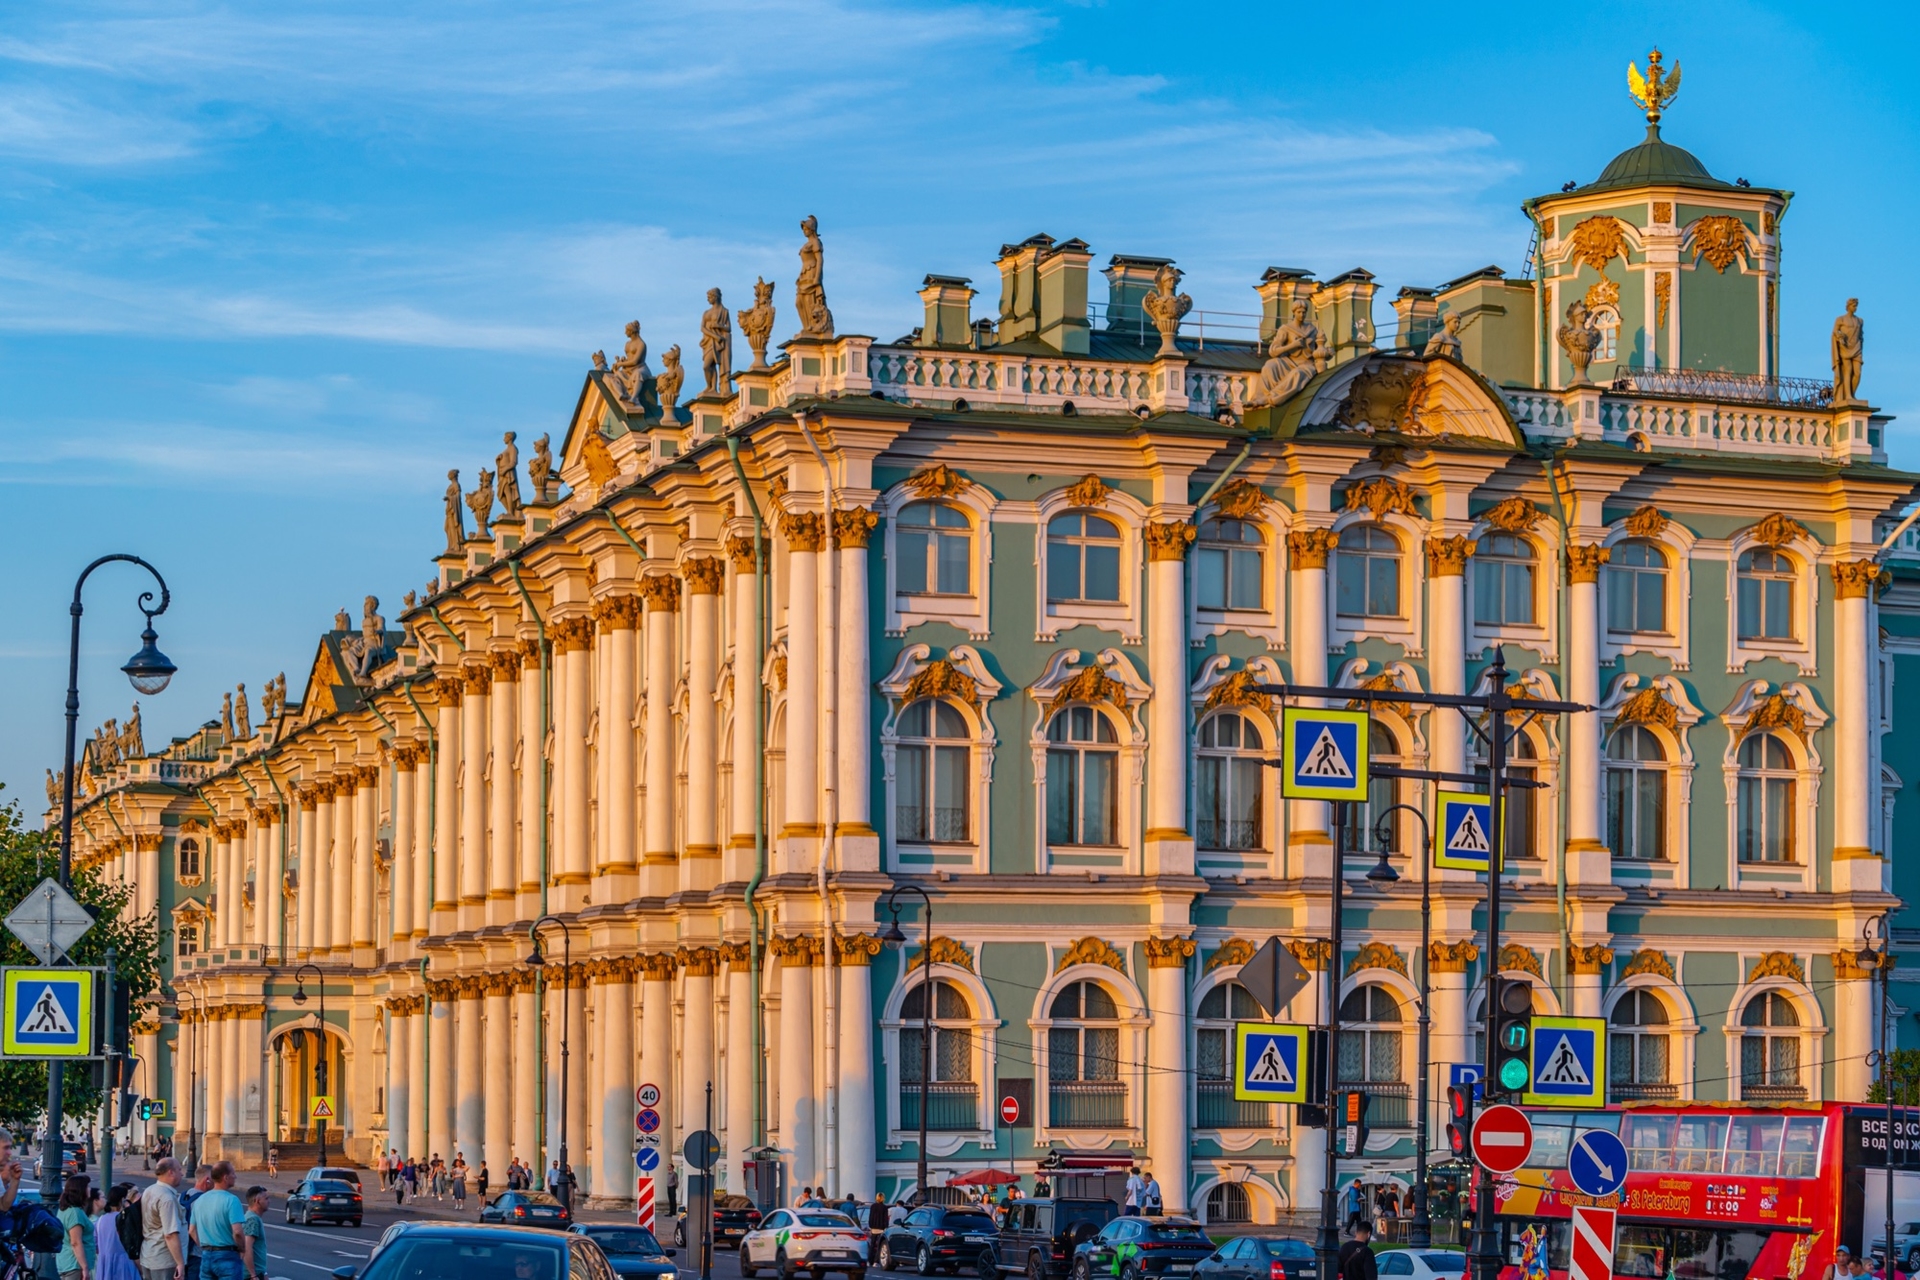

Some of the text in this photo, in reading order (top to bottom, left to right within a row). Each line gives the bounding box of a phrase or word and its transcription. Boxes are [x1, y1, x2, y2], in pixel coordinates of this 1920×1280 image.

[1510, 1026, 1526, 1047] 17
[641, 1091, 656, 1101] 40
[1862, 1120, 1888, 1134] ВСЕ
[1862, 1137, 1870, 1147] В
[1871, 1138, 1909, 1150] ОДОМ
[1631, 1189, 1691, 1214] St Petersburg
